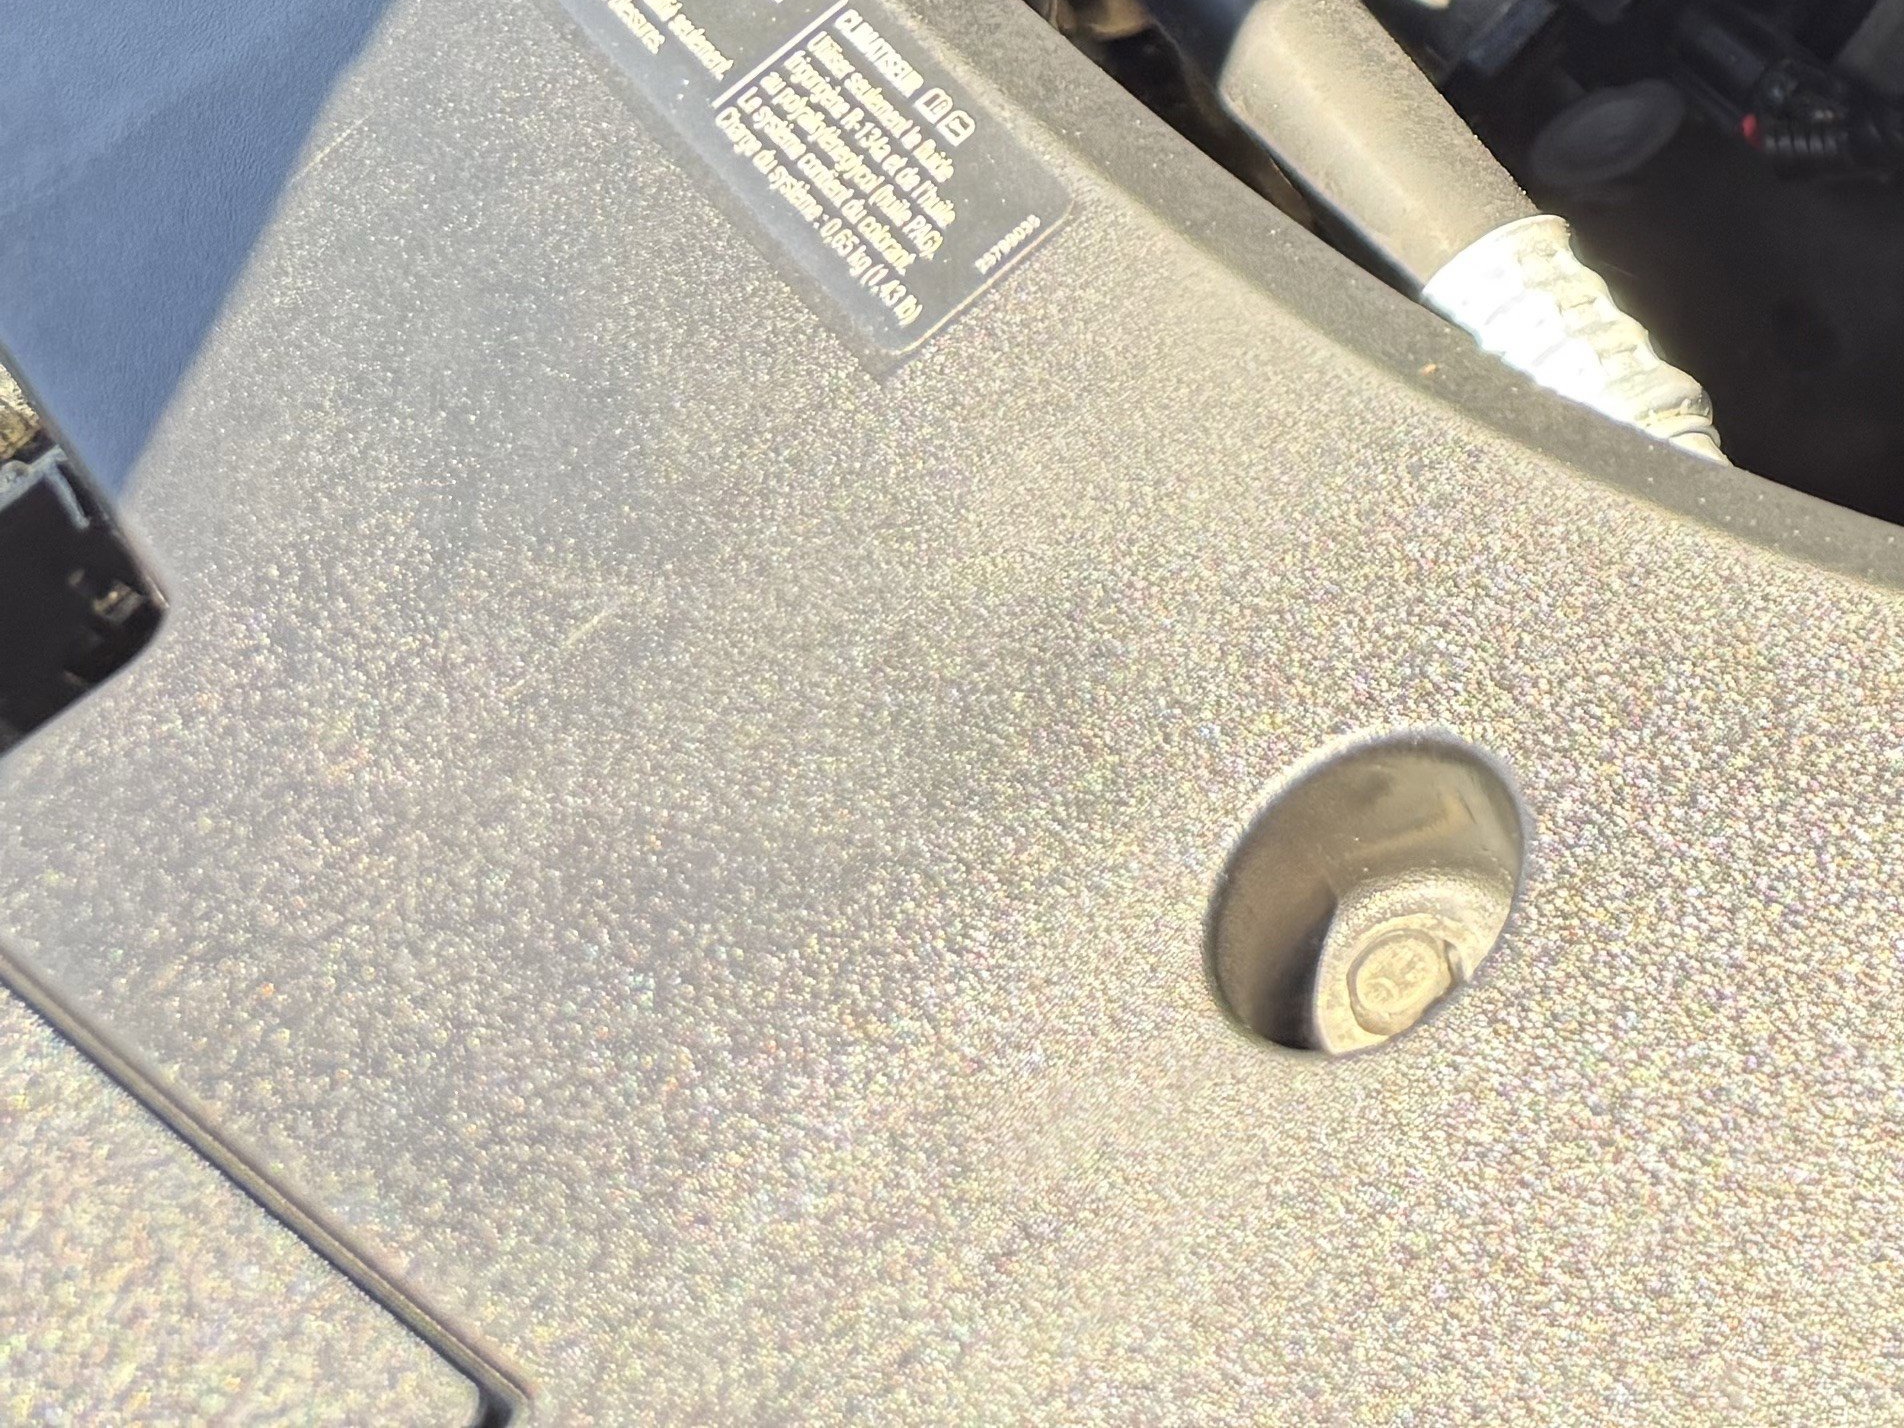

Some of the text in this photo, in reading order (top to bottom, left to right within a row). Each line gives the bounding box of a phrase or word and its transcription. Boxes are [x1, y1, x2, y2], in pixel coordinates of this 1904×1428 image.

[806, 30, 955, 183] Utiliser seulement le fluide
[833, 8, 924, 99] CLIMATISEUR
[736, 85, 917, 277] Le système contient du colorant.
[759, 71, 787, 97] au
[867, 183, 913, 228] (huile
[839, 107, 892, 164] R-134a
[881, 153, 909, 177] et
[894, 167, 921, 192] de
[714, 106, 763, 158] Charge
[751, 149, 779, 175] du
[767, 165, 824, 223] système
[819, 217, 860, 258] 0,65
[846, 244, 873, 279] kg
[892, 294, 923, 329] lb)
